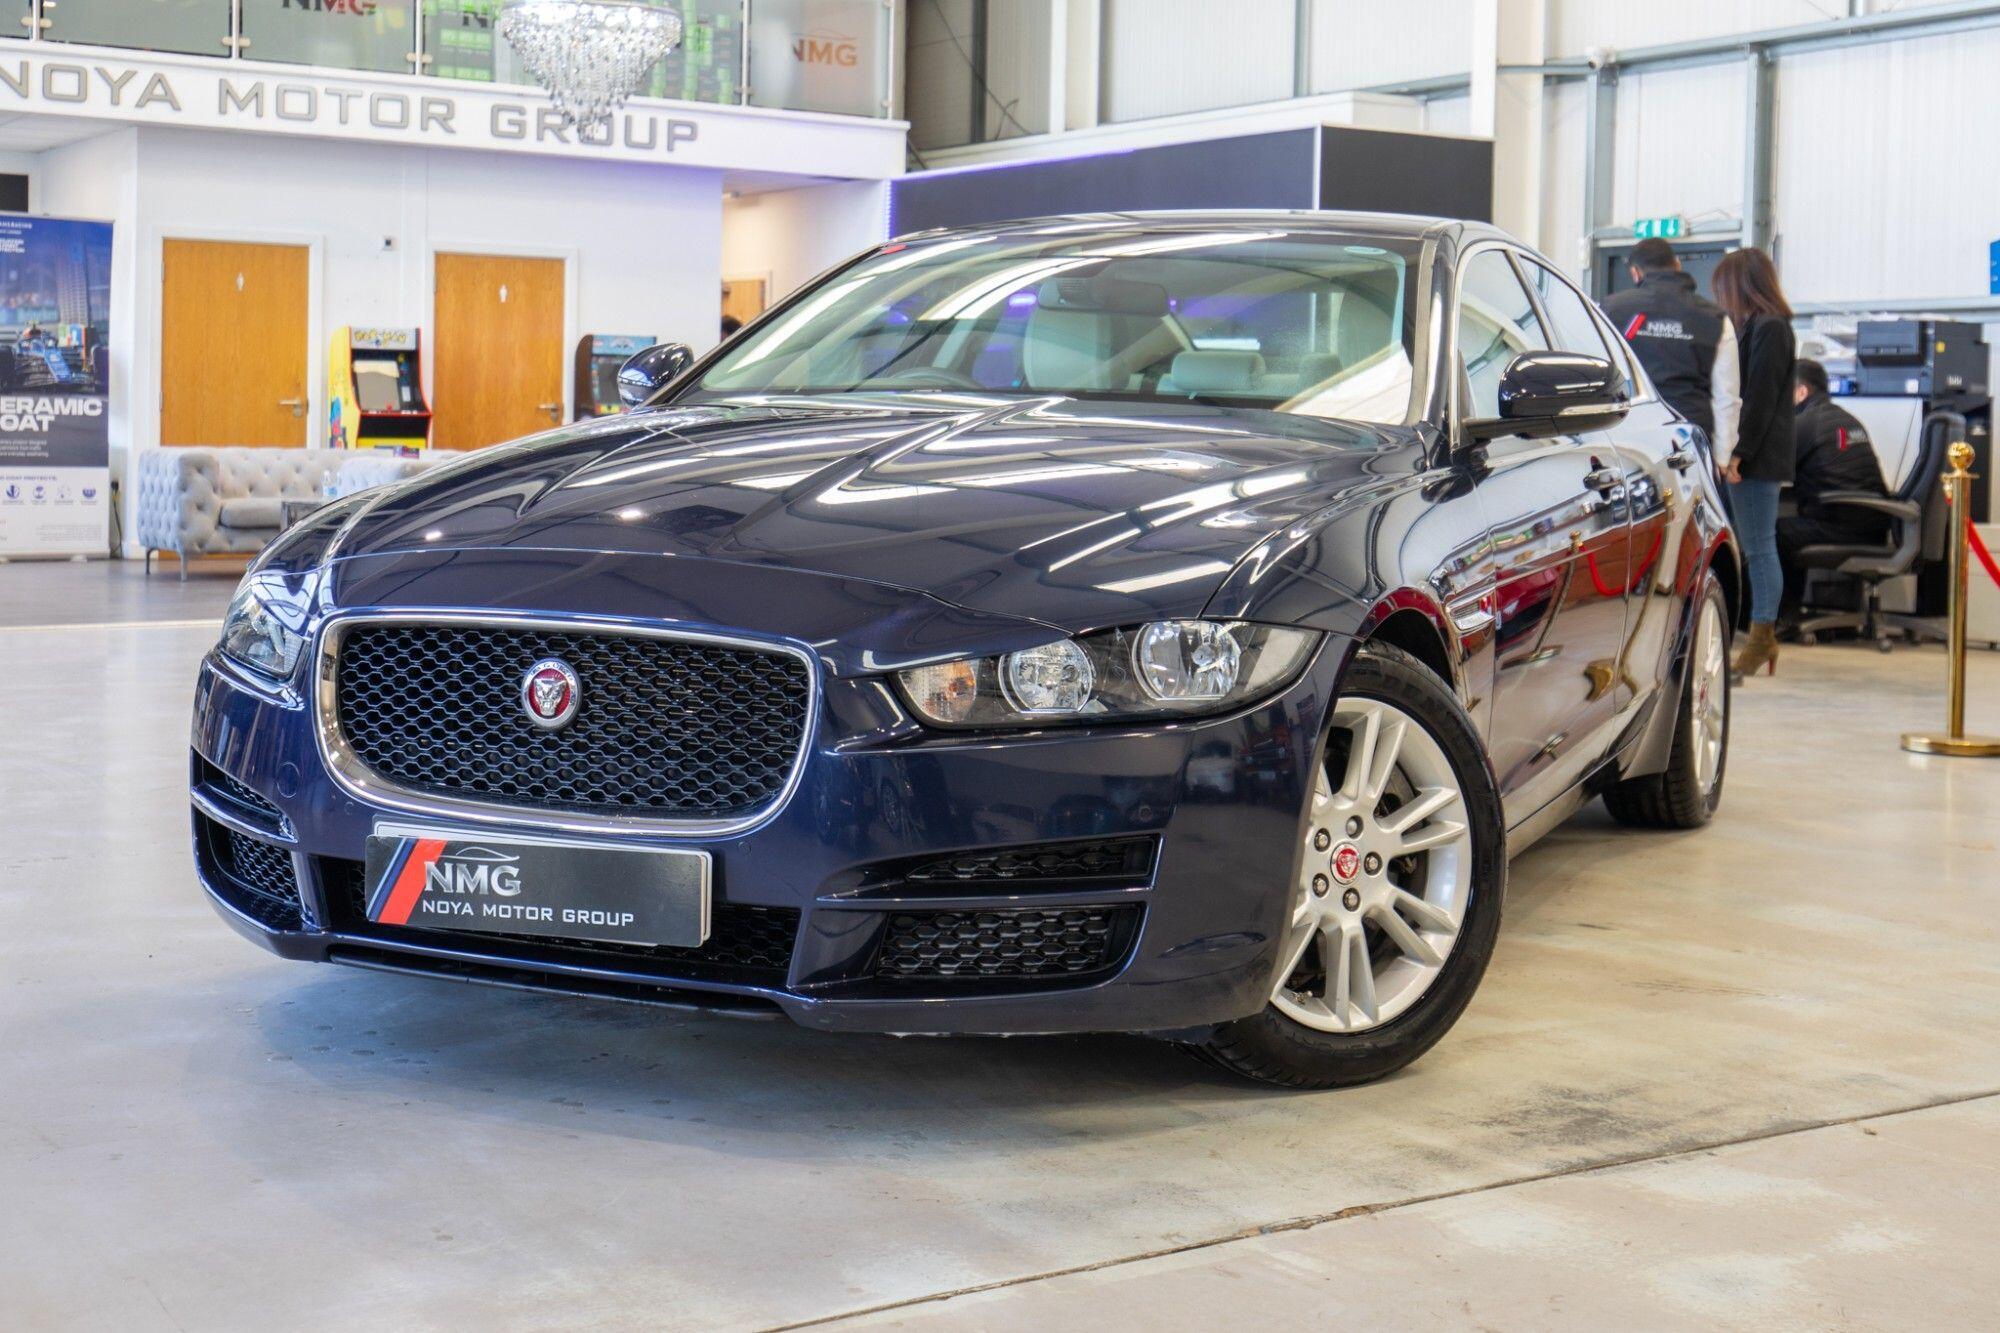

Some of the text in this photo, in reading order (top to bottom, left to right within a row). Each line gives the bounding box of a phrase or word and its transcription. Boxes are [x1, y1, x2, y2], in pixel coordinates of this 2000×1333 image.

[792, 38, 858, 67] NMG
[0, 60, 182, 111] NOYA
[218, 77, 456, 134] MOTOR
[424, 861, 521, 897] NMG
[422, 900, 634, 927] NOYA MOTOR GROUP
